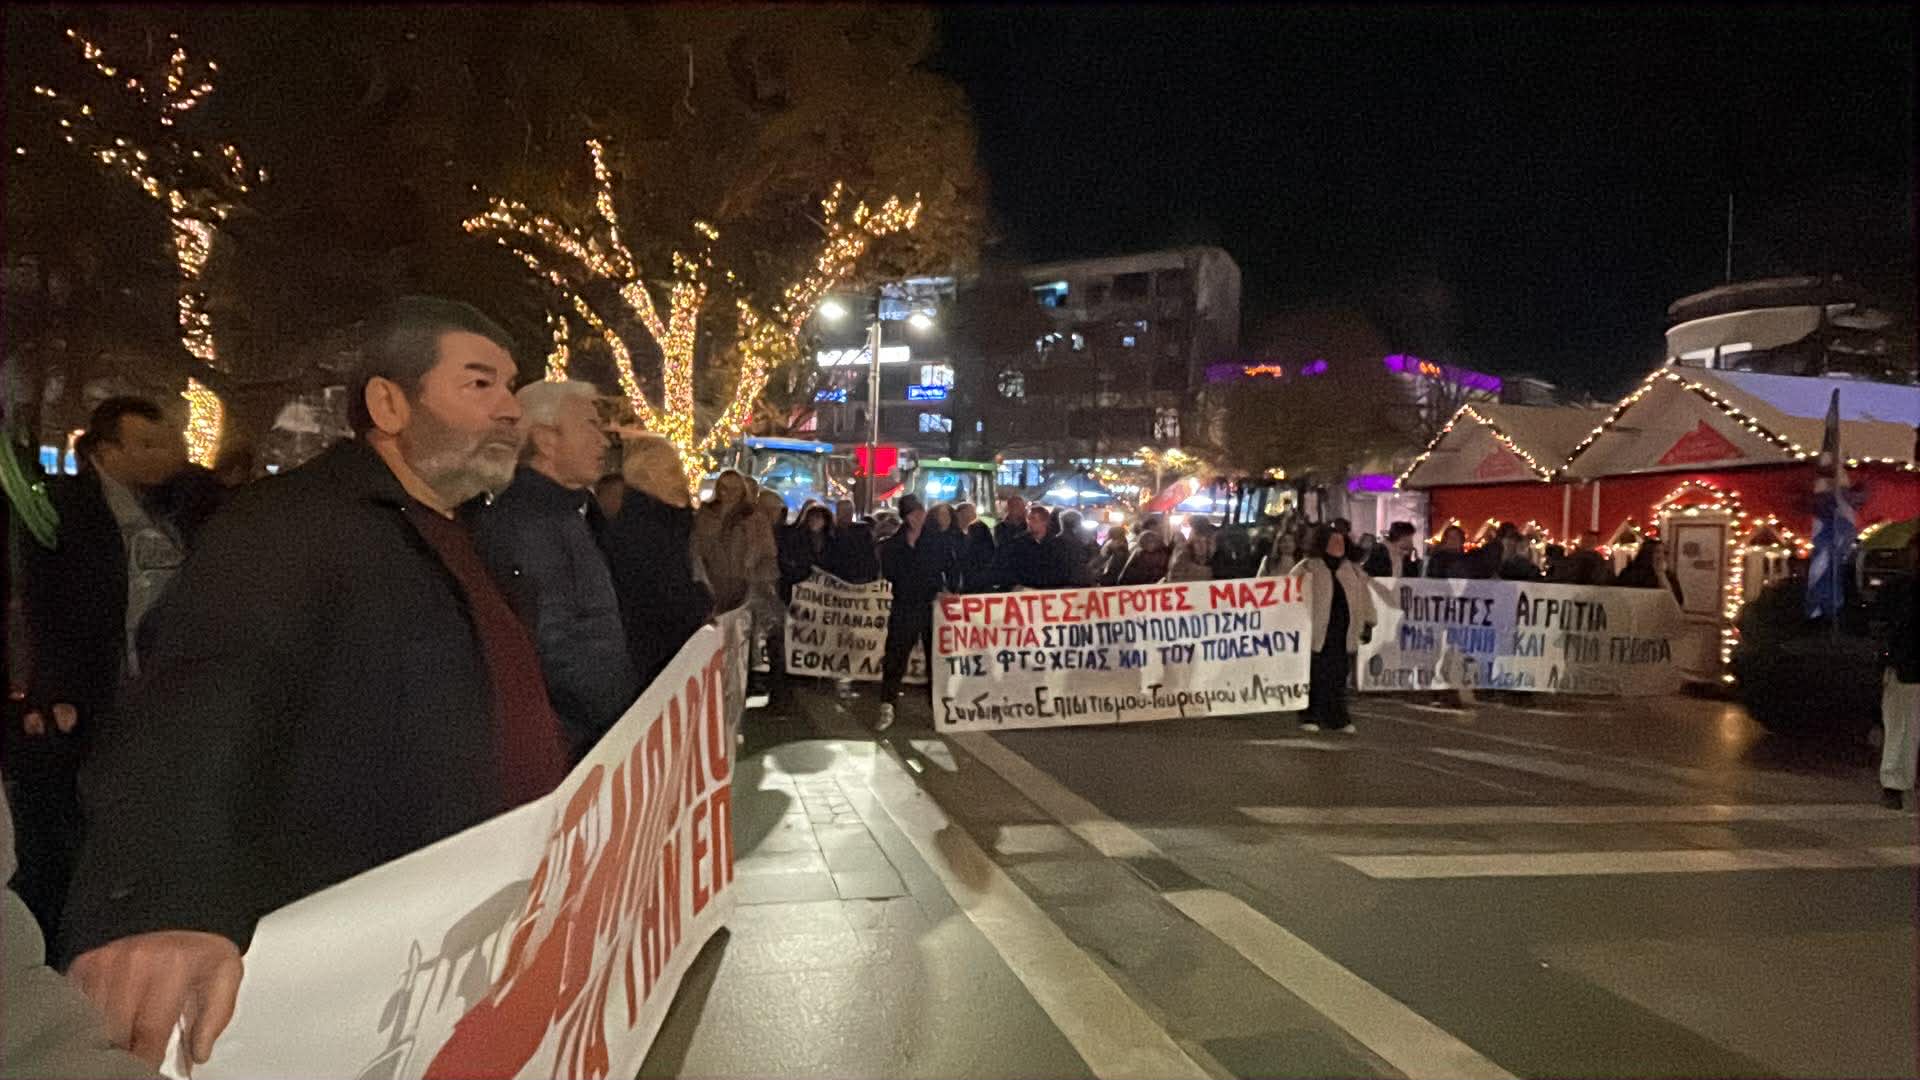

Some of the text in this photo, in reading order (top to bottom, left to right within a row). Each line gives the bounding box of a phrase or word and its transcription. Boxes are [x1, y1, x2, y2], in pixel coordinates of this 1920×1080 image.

[939, 586, 1193, 625] ΕΡΓΑΤΕΣ-ΑΓΡΟΤΕΣ
[1400, 585, 1495, 626] ΦΟΙΤΗΤΕΣ
[938, 624, 1040, 655] ΕΝΑΝΤΙΑ
[1042, 624, 1092, 648] ΣΤΟΝ
[946, 655, 987, 676] ΤΗΣ
[996, 648, 1112, 673] ΦΤΩΧΕΙΑΣ
[1155, 644, 1196, 665] ΤΟΥ
[1201, 630, 1300, 661] ΠΟΛΕΜΟΥ
[1513, 631, 1546, 657] ΚΑΙ
[791, 649, 850, 674] ΕΦΚΑ
